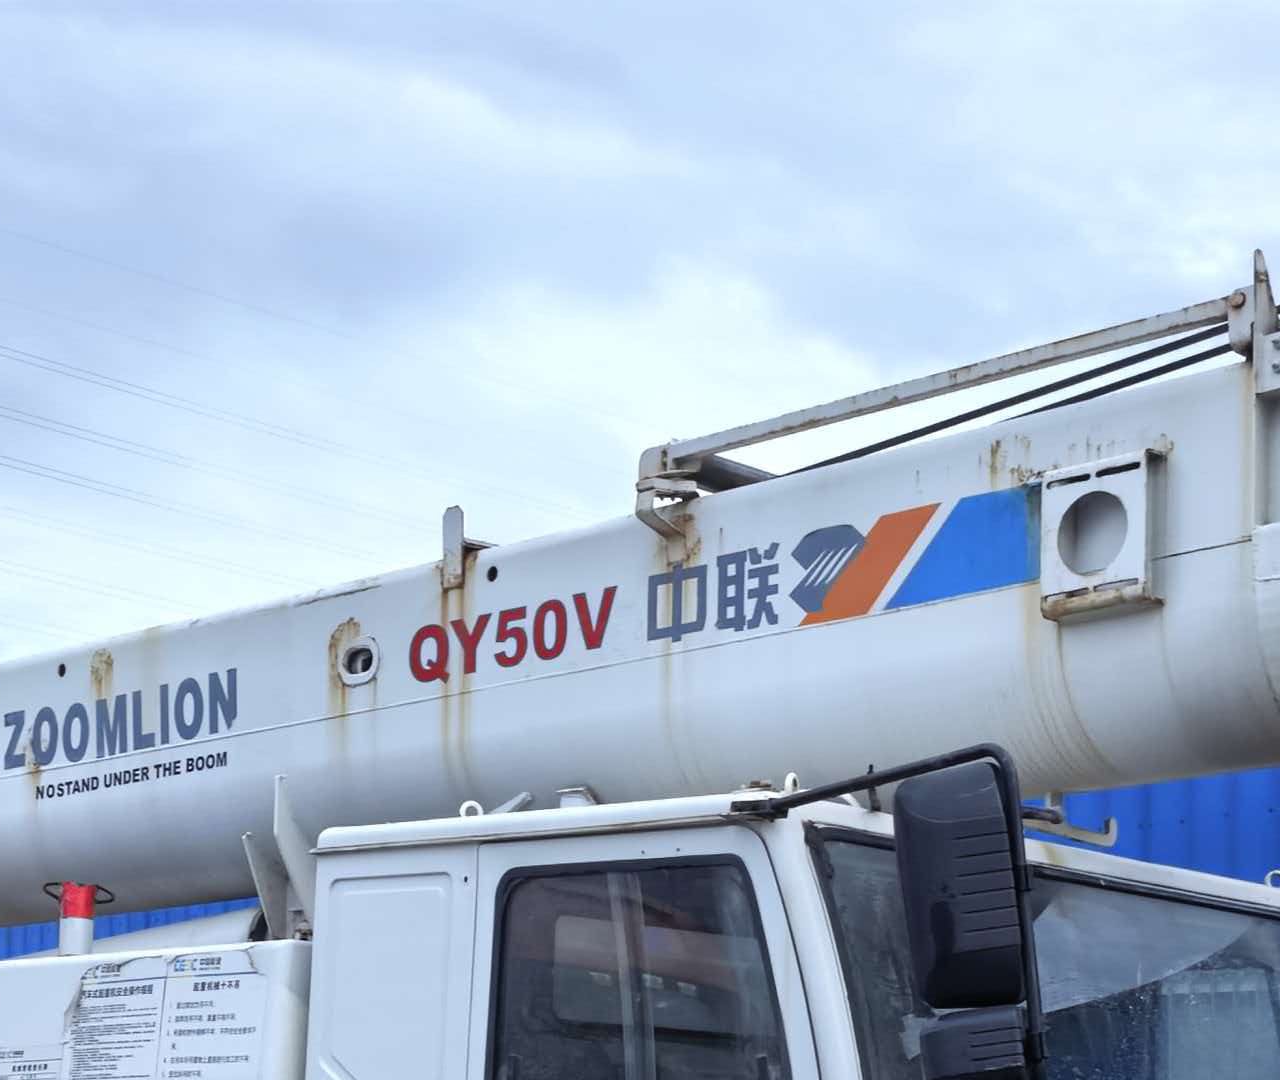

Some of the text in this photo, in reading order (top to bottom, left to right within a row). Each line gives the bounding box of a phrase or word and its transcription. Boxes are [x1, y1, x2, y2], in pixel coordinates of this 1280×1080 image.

[408, 585, 618, 685] QY50V
[646, 541, 780, 642] 中联
[3, 668, 238, 770] ZOOMLION
[103, 766, 150, 788] UNDER
[154, 759, 181, 779] THE
[186, 751, 228, 773] BOOM
